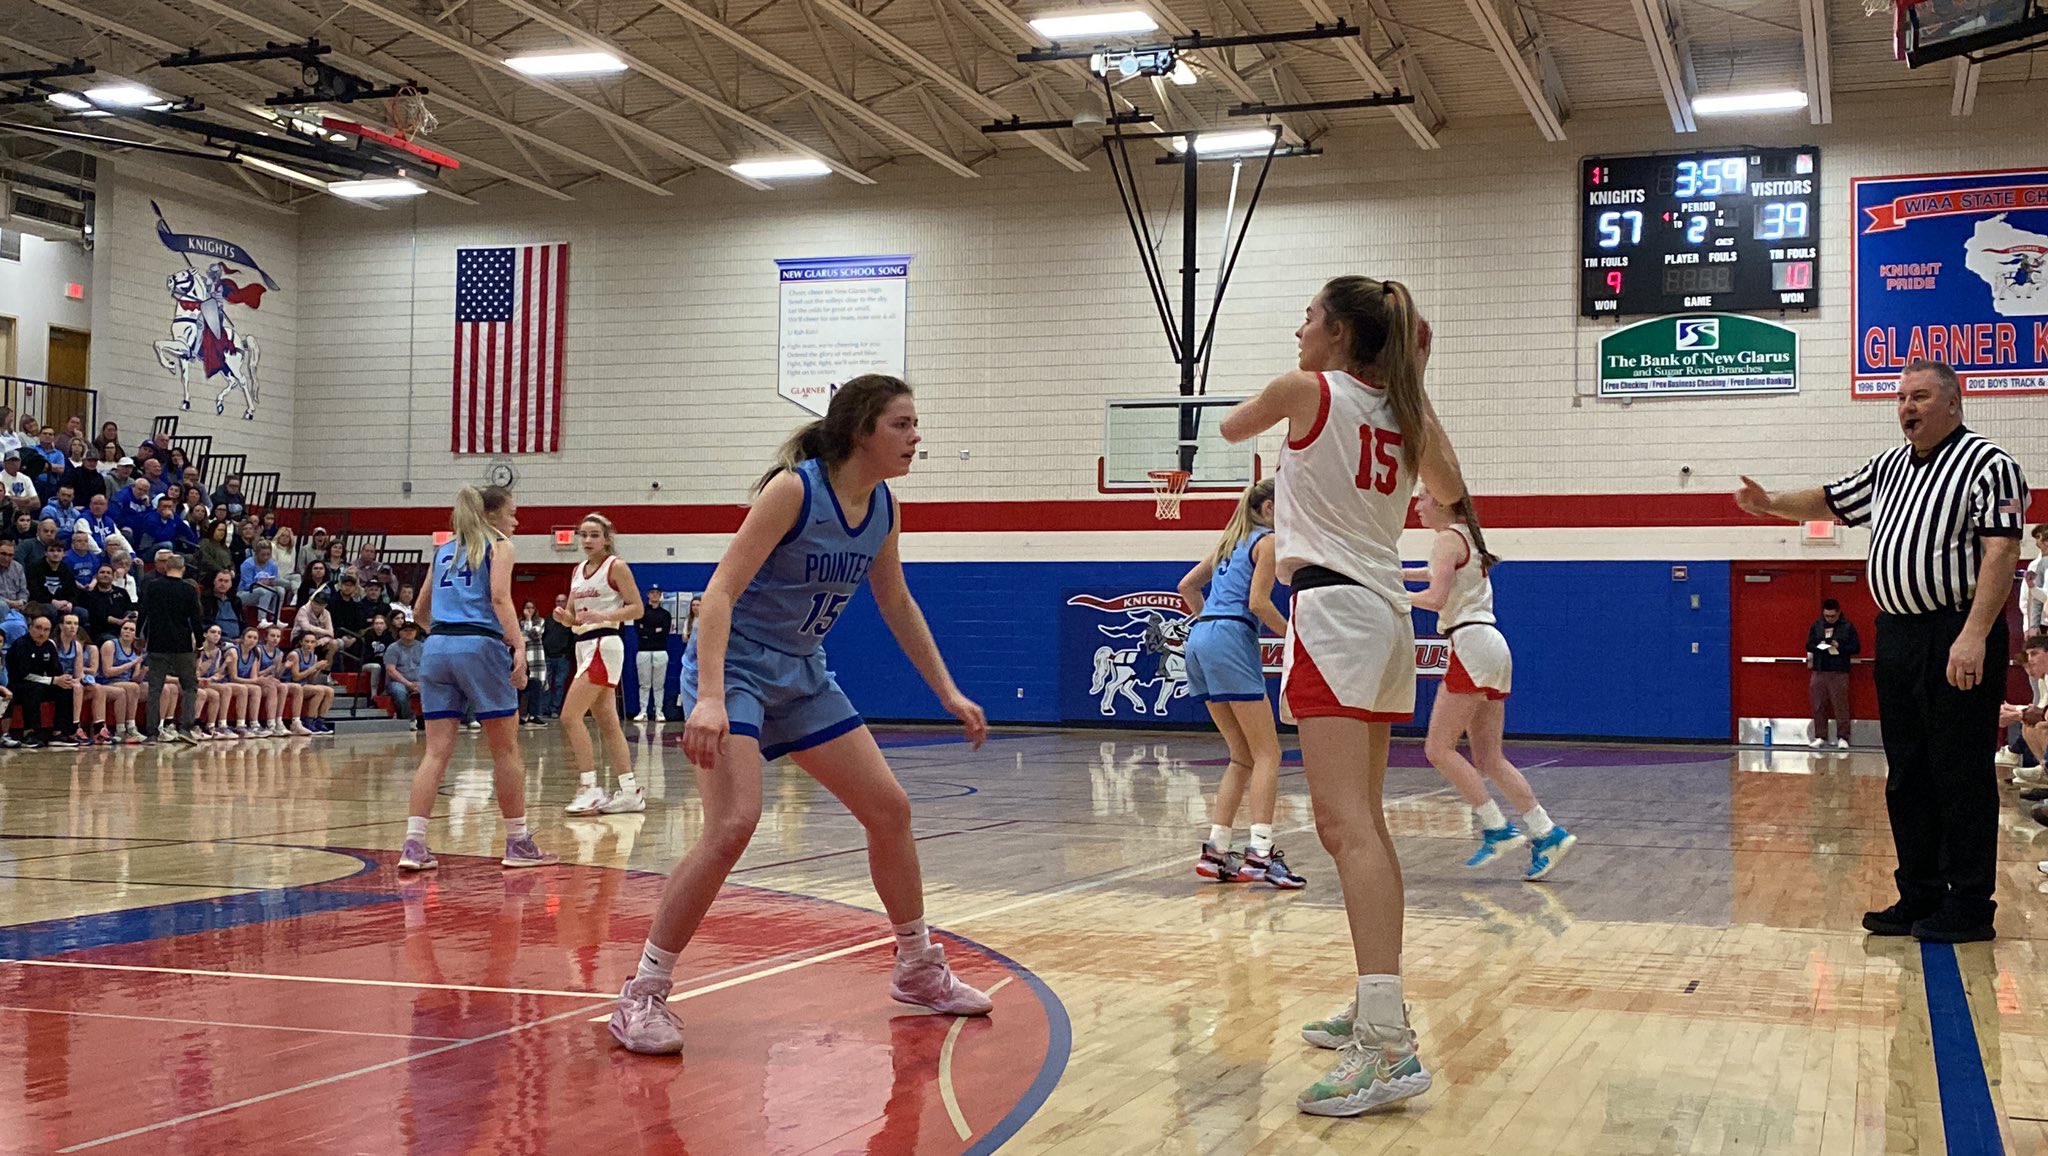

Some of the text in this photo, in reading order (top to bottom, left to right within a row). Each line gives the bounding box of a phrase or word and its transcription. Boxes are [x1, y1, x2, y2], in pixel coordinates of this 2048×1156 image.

[1674, 159, 1743, 197] 3:59
[1751, 180, 1812, 196] VISITORS
[1589, 189, 1646, 206] KNIGHTS
[1904, 196, 1953, 213] WIAA
[1961, 191, 2014, 208] STATE
[1681, 202, 1716, 212] PERIOD
[1764, 202, 1807, 238] 39
[1599, 211, 1643, 248] 57
[1687, 215, 1708, 243] 2
[188, 237, 235, 258] KNIGHTS
[1769, 248, 1816, 260] TM FOULS
[1584, 256, 1629, 268] TM FOULS
[1664, 251, 1737, 265] PLAYER FOULS
[782, 265, 904, 279] NEW GLARUS SCHOOL SONG
[1785, 263, 1809, 289] 10
[1879, 263, 1942, 277] KNIGHT
[1606, 271, 1622, 294] 9
[1887, 277, 1936, 290] PRIDE
[1595, 300, 1617, 311] WON
[1684, 296, 1712, 308] GAME
[1781, 293, 1805, 304] WON
[1864, 323, 2017, 368] GLARNER
[1607, 351, 1790, 368] The Bank of New Glarus
[1633, 367, 1652, 377] and
[1654, 367, 1684, 378] Sugar
[1686, 366, 1714, 375] River
[1716, 364, 1763, 374] Branches
[1605, 381, 1619, 390] Free
[1620, 381, 1648, 390] Checking
[1653, 380, 1667, 388] Free
[1667, 379, 1696, 388] Business
[1697, 379, 1726, 388] Checking
[1730, 378, 1745, 386] Free
[1858, 382, 1896, 392] 1996 BOYS
[1968, 377, 2045, 389] 2012 BOYS TRACK &
[791, 387, 826, 395] GLARNER
[1355, 423, 1404, 496] 15
[440, 554, 472, 588] 24
[1123, 595, 1182, 609] KNIGHTS
[798, 591, 850, 636] 15
